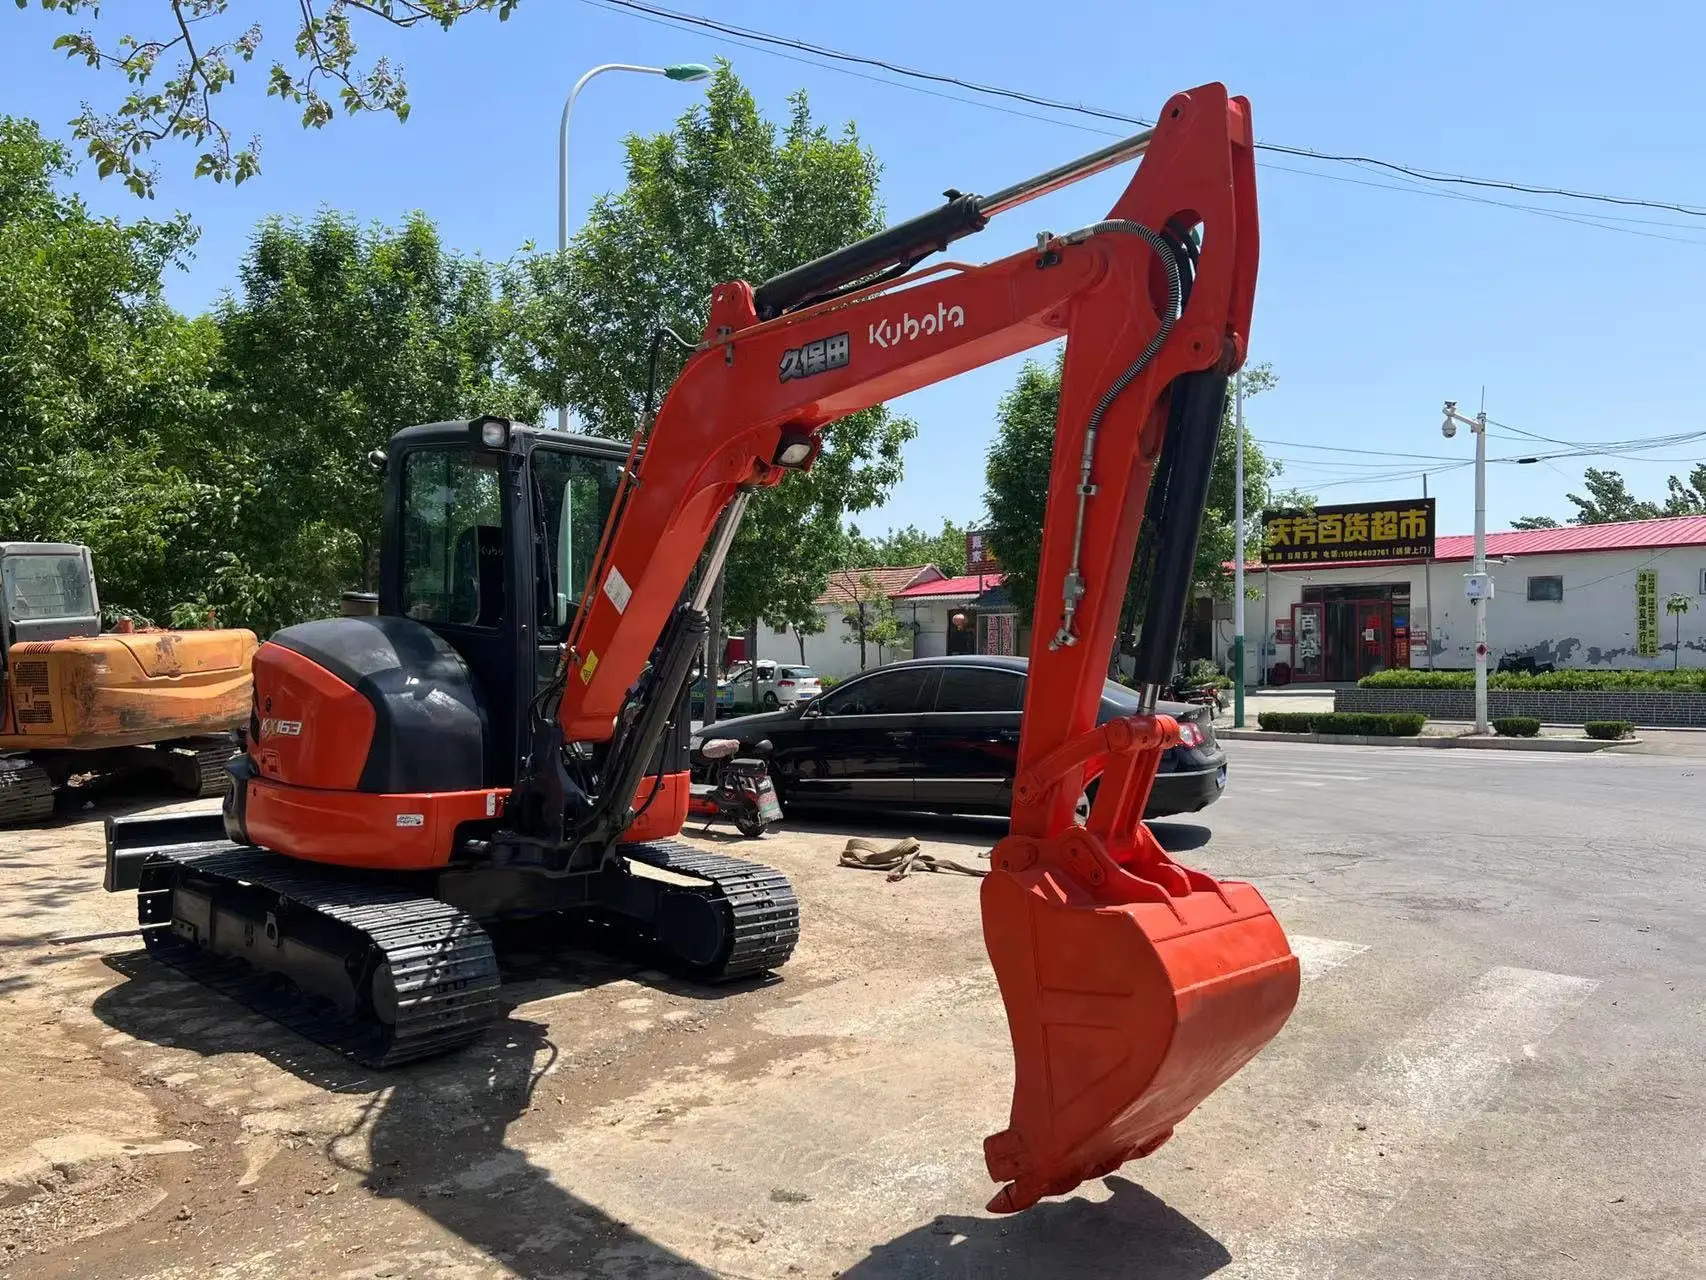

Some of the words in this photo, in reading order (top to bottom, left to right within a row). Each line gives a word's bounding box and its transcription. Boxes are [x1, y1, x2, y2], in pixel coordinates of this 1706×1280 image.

[868, 302, 965, 348] Kubota
[779, 331, 850, 383] 久保田
[1267, 509, 1427, 545] 庆芳百货超市
[261, 717, 303, 738] KX163
